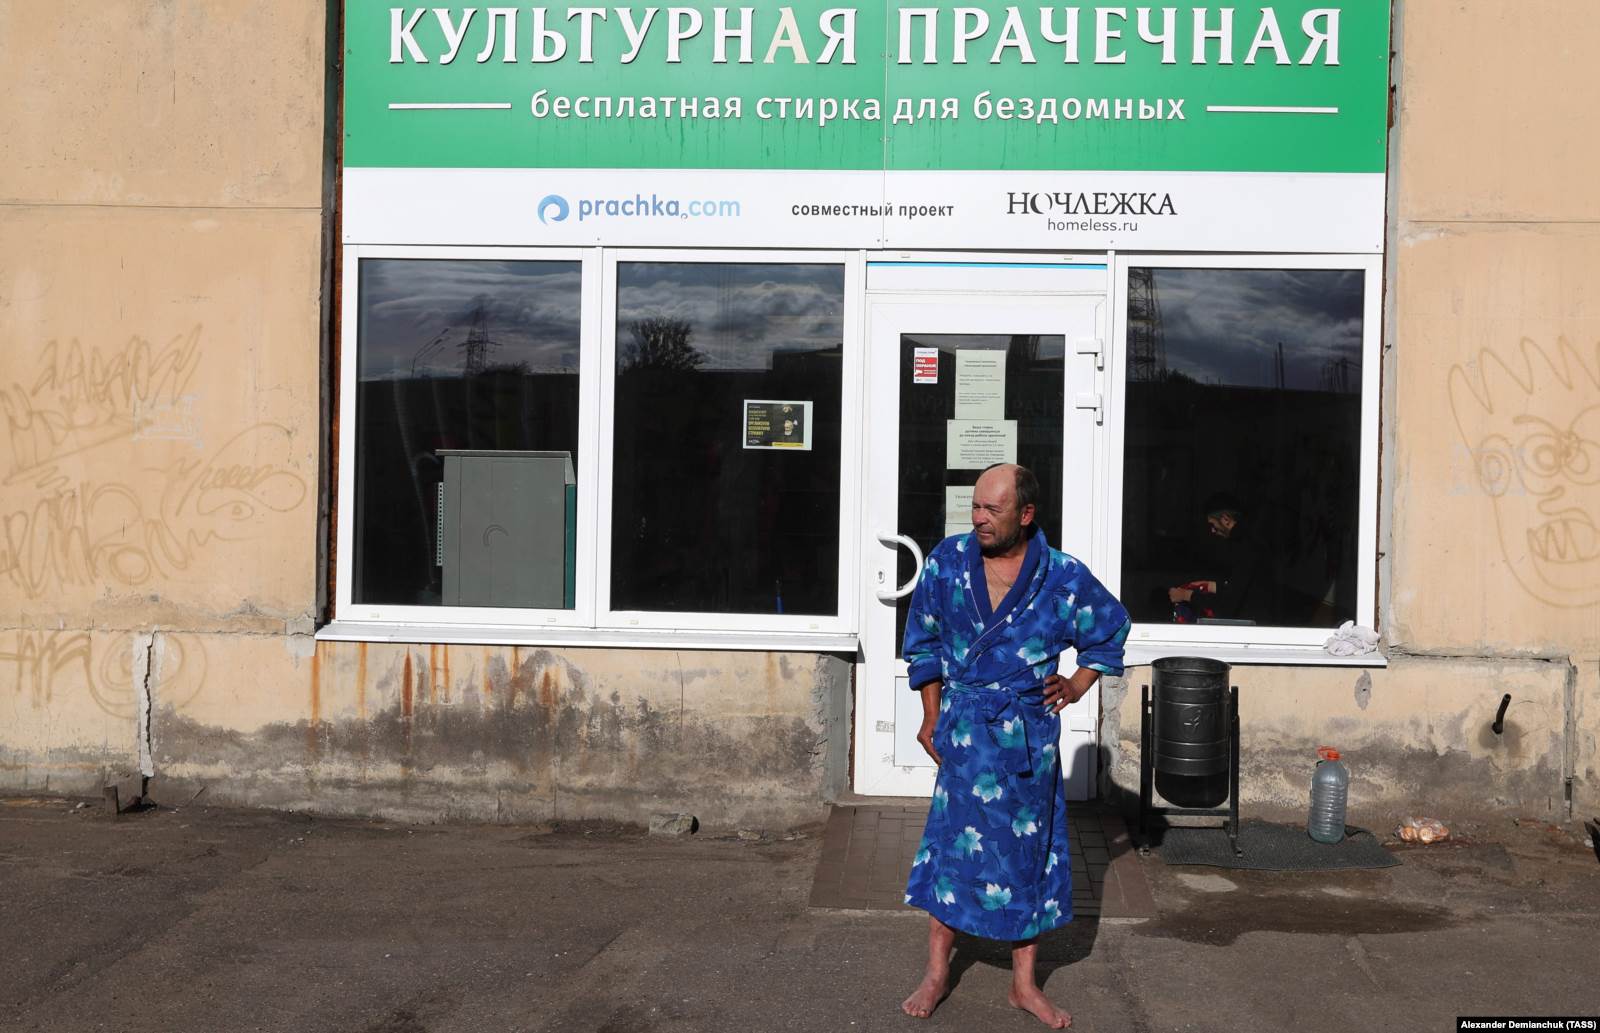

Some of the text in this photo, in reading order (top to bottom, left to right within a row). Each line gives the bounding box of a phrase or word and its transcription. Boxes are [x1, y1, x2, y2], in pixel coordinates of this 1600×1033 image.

[389, 6, 1341, 66] КУЛЬТУРНАЯ ПРАЧЕЧНАЯ
[531, 89, 1186, 127] бесплатная стирка для бездомных
[578, 193, 741, 221] prachka.com
[791, 202, 955, 220] совместный проект
[1006, 191, 1178, 215] НОЧЛЕЖКА
[1047, 217, 1138, 232] homeless.ru
